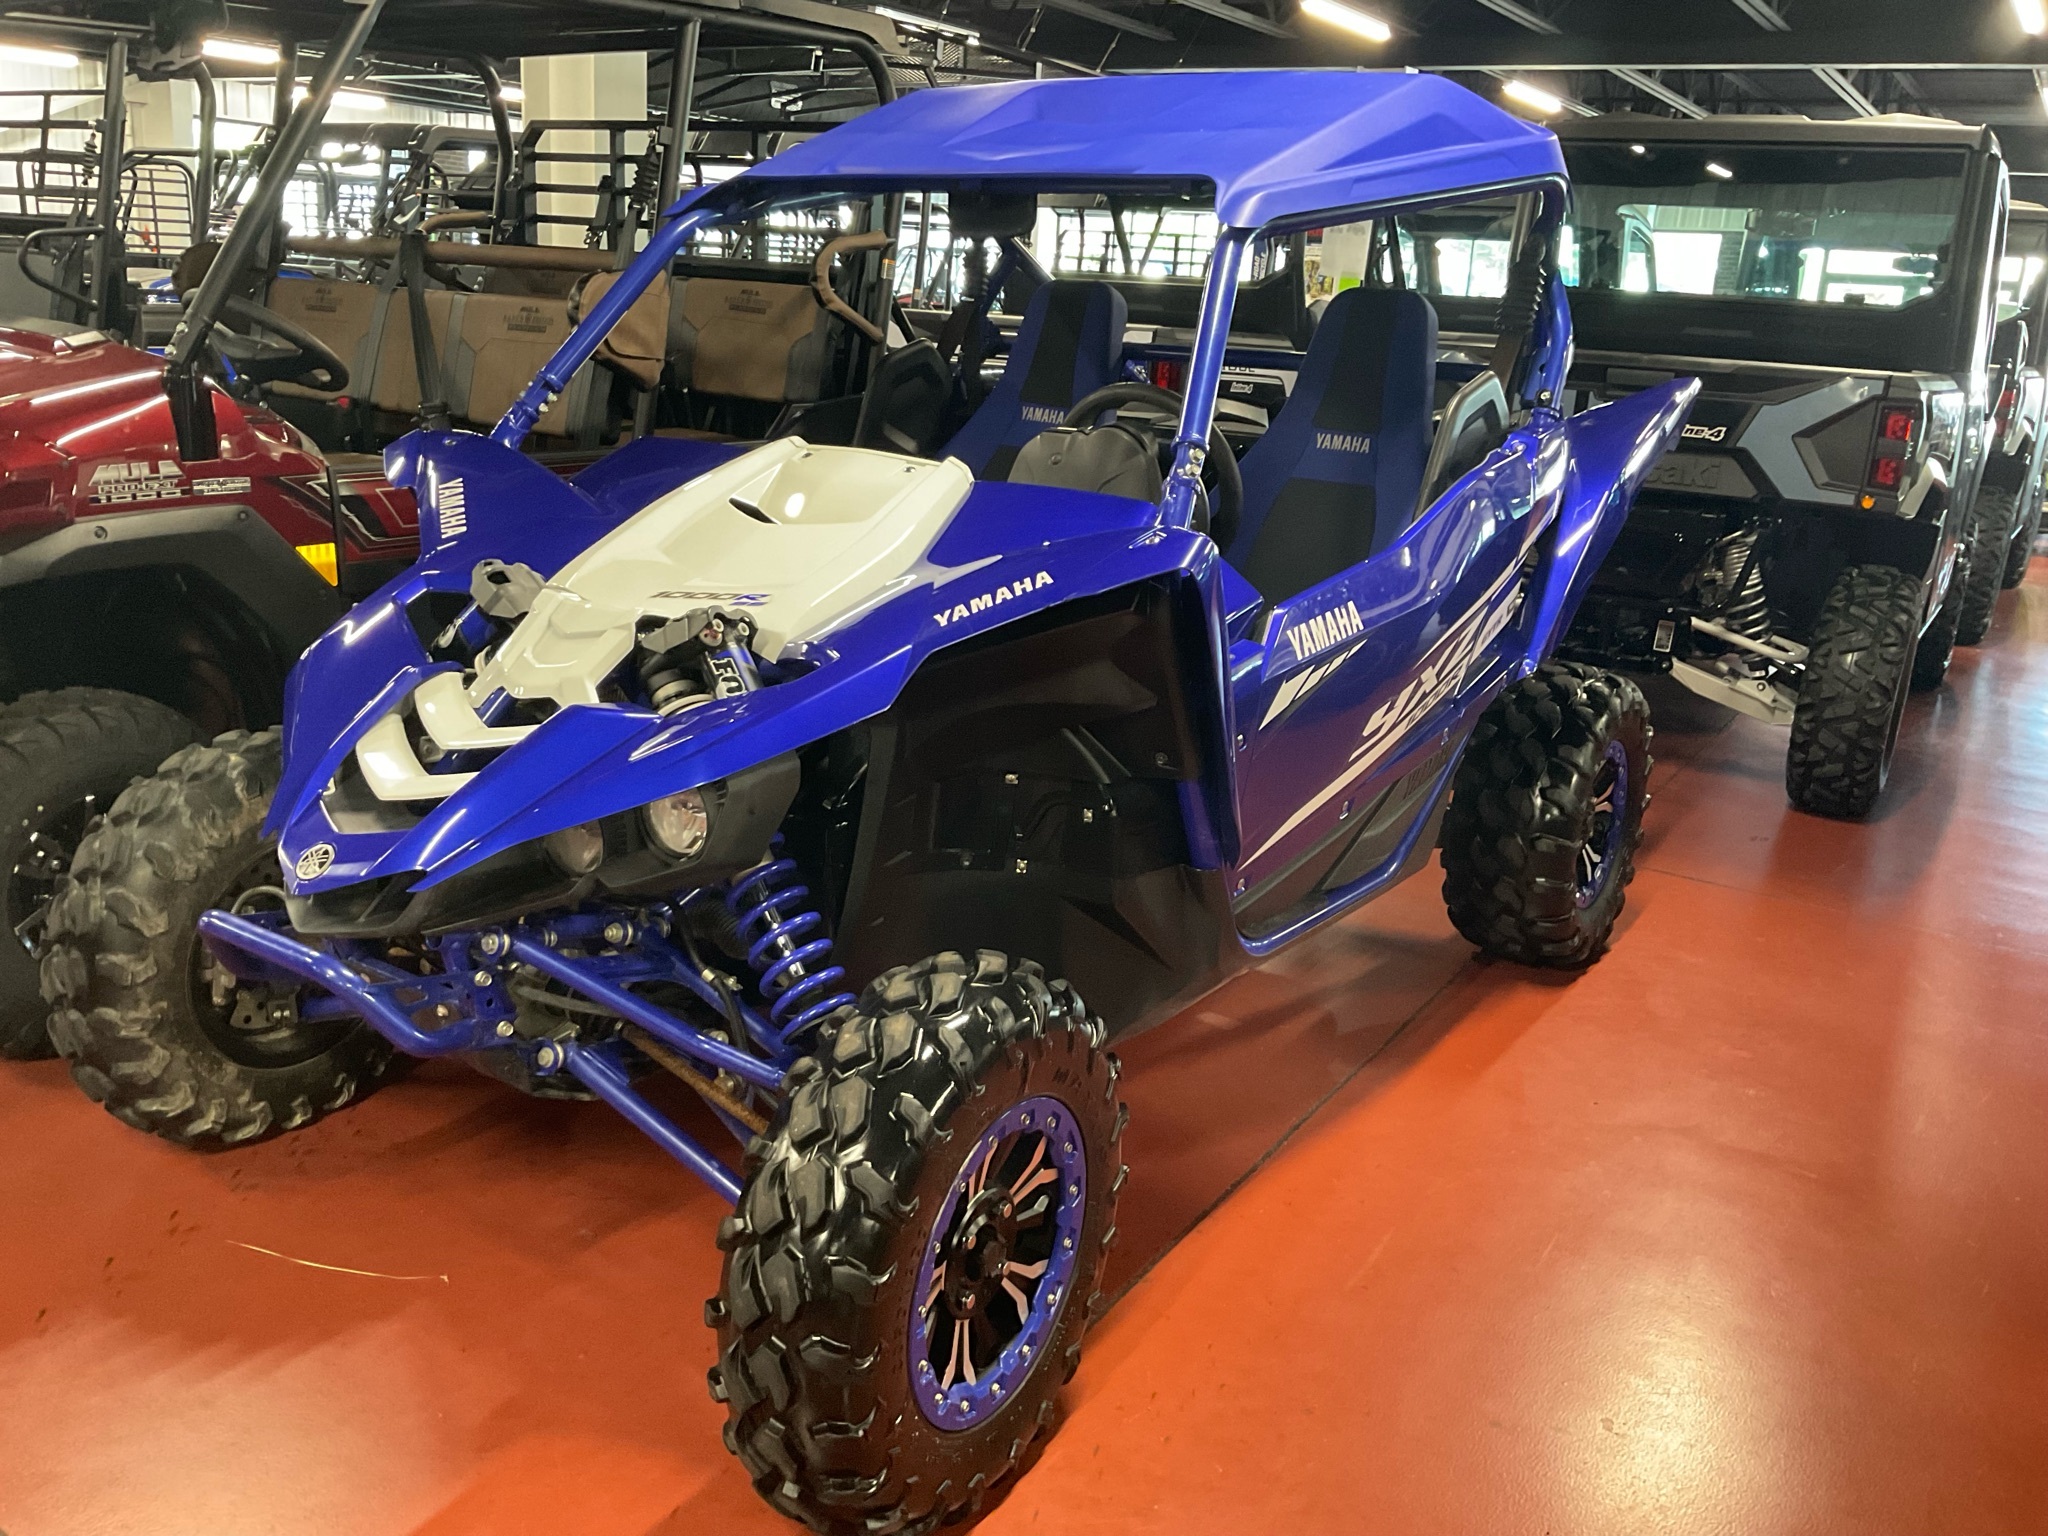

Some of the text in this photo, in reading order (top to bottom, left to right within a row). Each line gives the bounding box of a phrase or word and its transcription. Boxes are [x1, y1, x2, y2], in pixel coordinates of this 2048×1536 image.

[1022, 406, 1064, 424] YAMAHA
[1316, 432, 1371, 453] YAMAHA
[438, 477, 468, 539] YAMAHA
[650, 591, 771, 601] 1000R
[933, 570, 1054, 627] YAMAHA
[1286, 600, 1364, 661] YAMAHA
